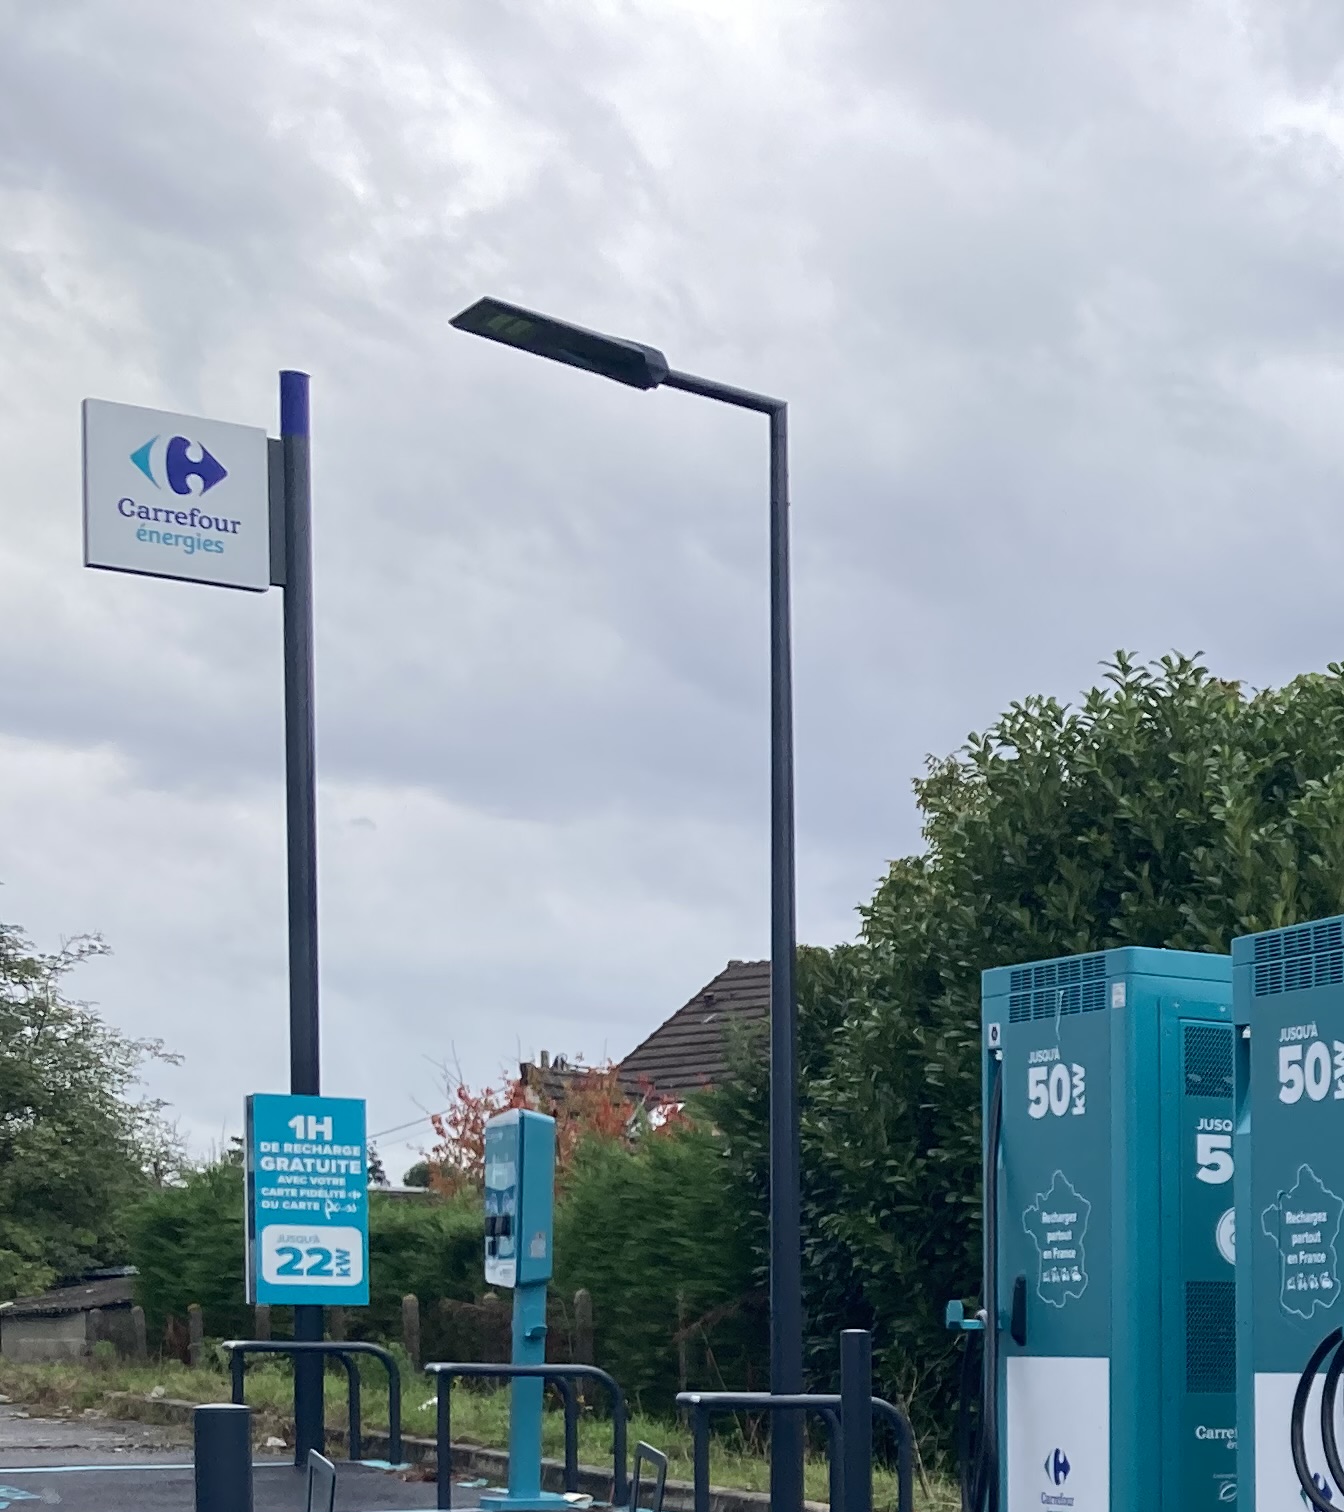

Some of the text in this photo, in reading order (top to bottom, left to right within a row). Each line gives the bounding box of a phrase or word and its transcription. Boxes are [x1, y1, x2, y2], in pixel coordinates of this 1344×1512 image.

[118, 497, 242, 534] Carrefour
[136, 523, 224, 554] énergies
[1279, 1021, 1319, 1042] JUSQU'À
[1278, 1040, 1332, 1104] 50
[1027, 1063, 1071, 1119] 50
[287, 1114, 333, 1141] 1H
[1196, 1118, 1234, 1132] JUSQ
[260, 1141, 361, 1157] DE RECHARGE
[1195, 1133, 1235, 1184] 5
[260, 1156, 362, 1175] GRATUITE
[277, 1175, 346, 1187] AVEC VOTRE
[261, 1187, 298, 1198] CARTE
[261, 1200, 279, 1210] OU
[282, 1201, 321, 1211] CARTE
[275, 1246, 334, 1277] 22
[1299, 1250, 1327, 1265] France
[1195, 1425, 1238, 1440] Carre
